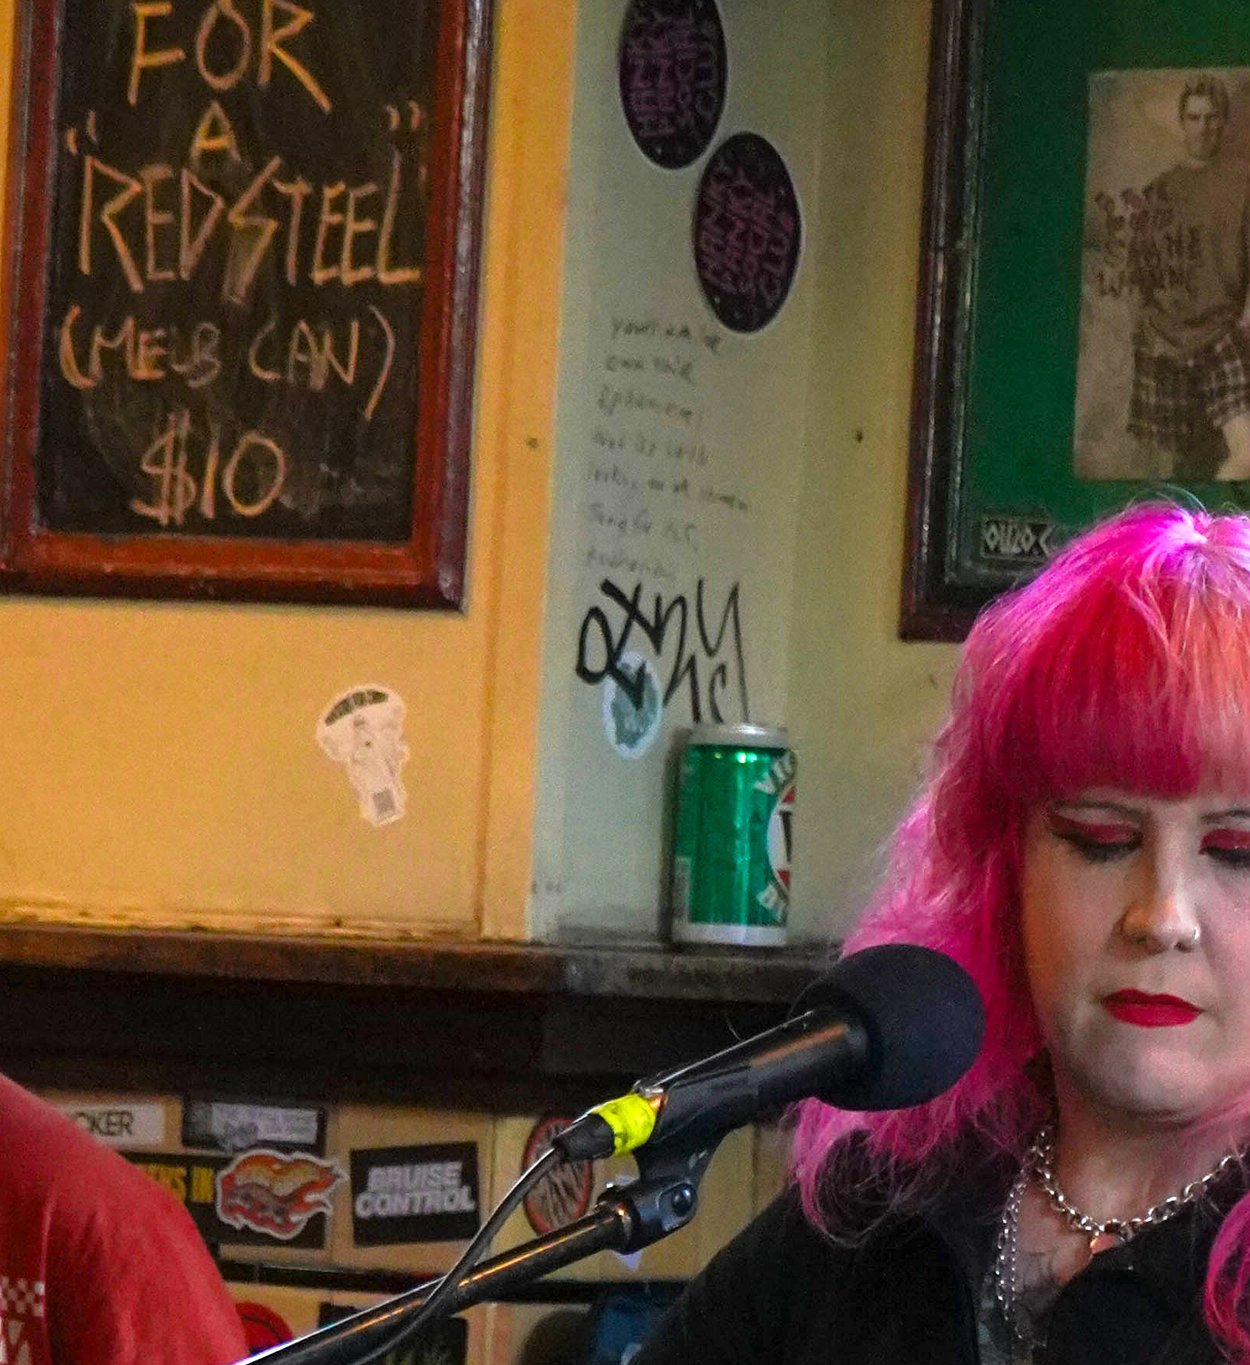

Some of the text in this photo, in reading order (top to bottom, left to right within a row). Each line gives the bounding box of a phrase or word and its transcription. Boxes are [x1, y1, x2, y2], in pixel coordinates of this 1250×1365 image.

[128, 0, 332, 112] FOR
[132, 408, 288, 525] $10
[354, 1184, 476, 1219] CONTROL
[367, 1160, 463, 1194] BRUISE
